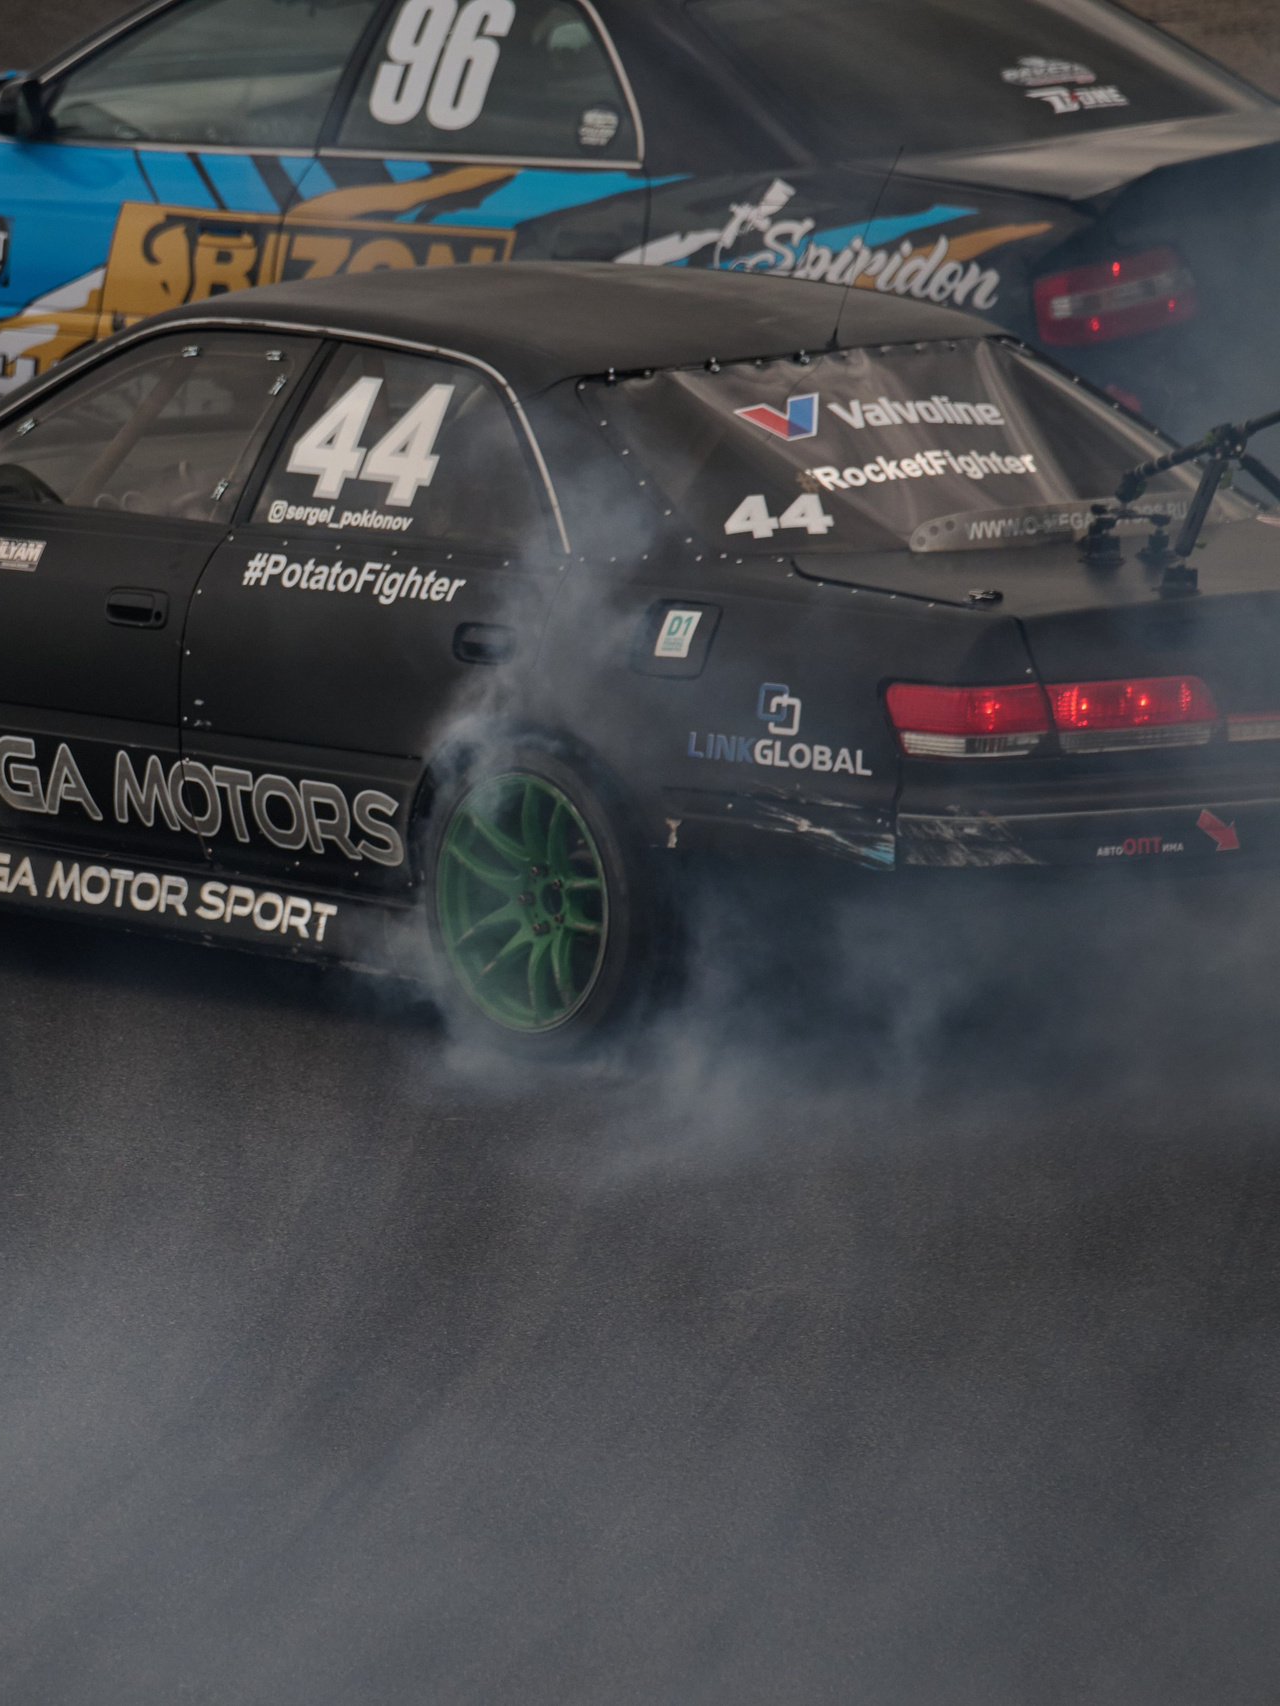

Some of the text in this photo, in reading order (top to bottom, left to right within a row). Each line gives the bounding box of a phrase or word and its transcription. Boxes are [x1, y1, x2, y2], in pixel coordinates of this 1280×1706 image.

[370, 0, 516, 130] 96
[732, 218, 1001, 309] Spiridon
[286, 375, 456, 507] 44
[827, 396, 1005, 429] Valvoline
[724, 494, 835, 539] 44
[241, 552, 467, 605] #PotatoFighter
[687, 732, 873, 776] LINKGLOBAL
[114, 749, 406, 867] MOTORS
[45, 860, 189, 917] MOTOR
[195, 881, 338, 942] SPORT
